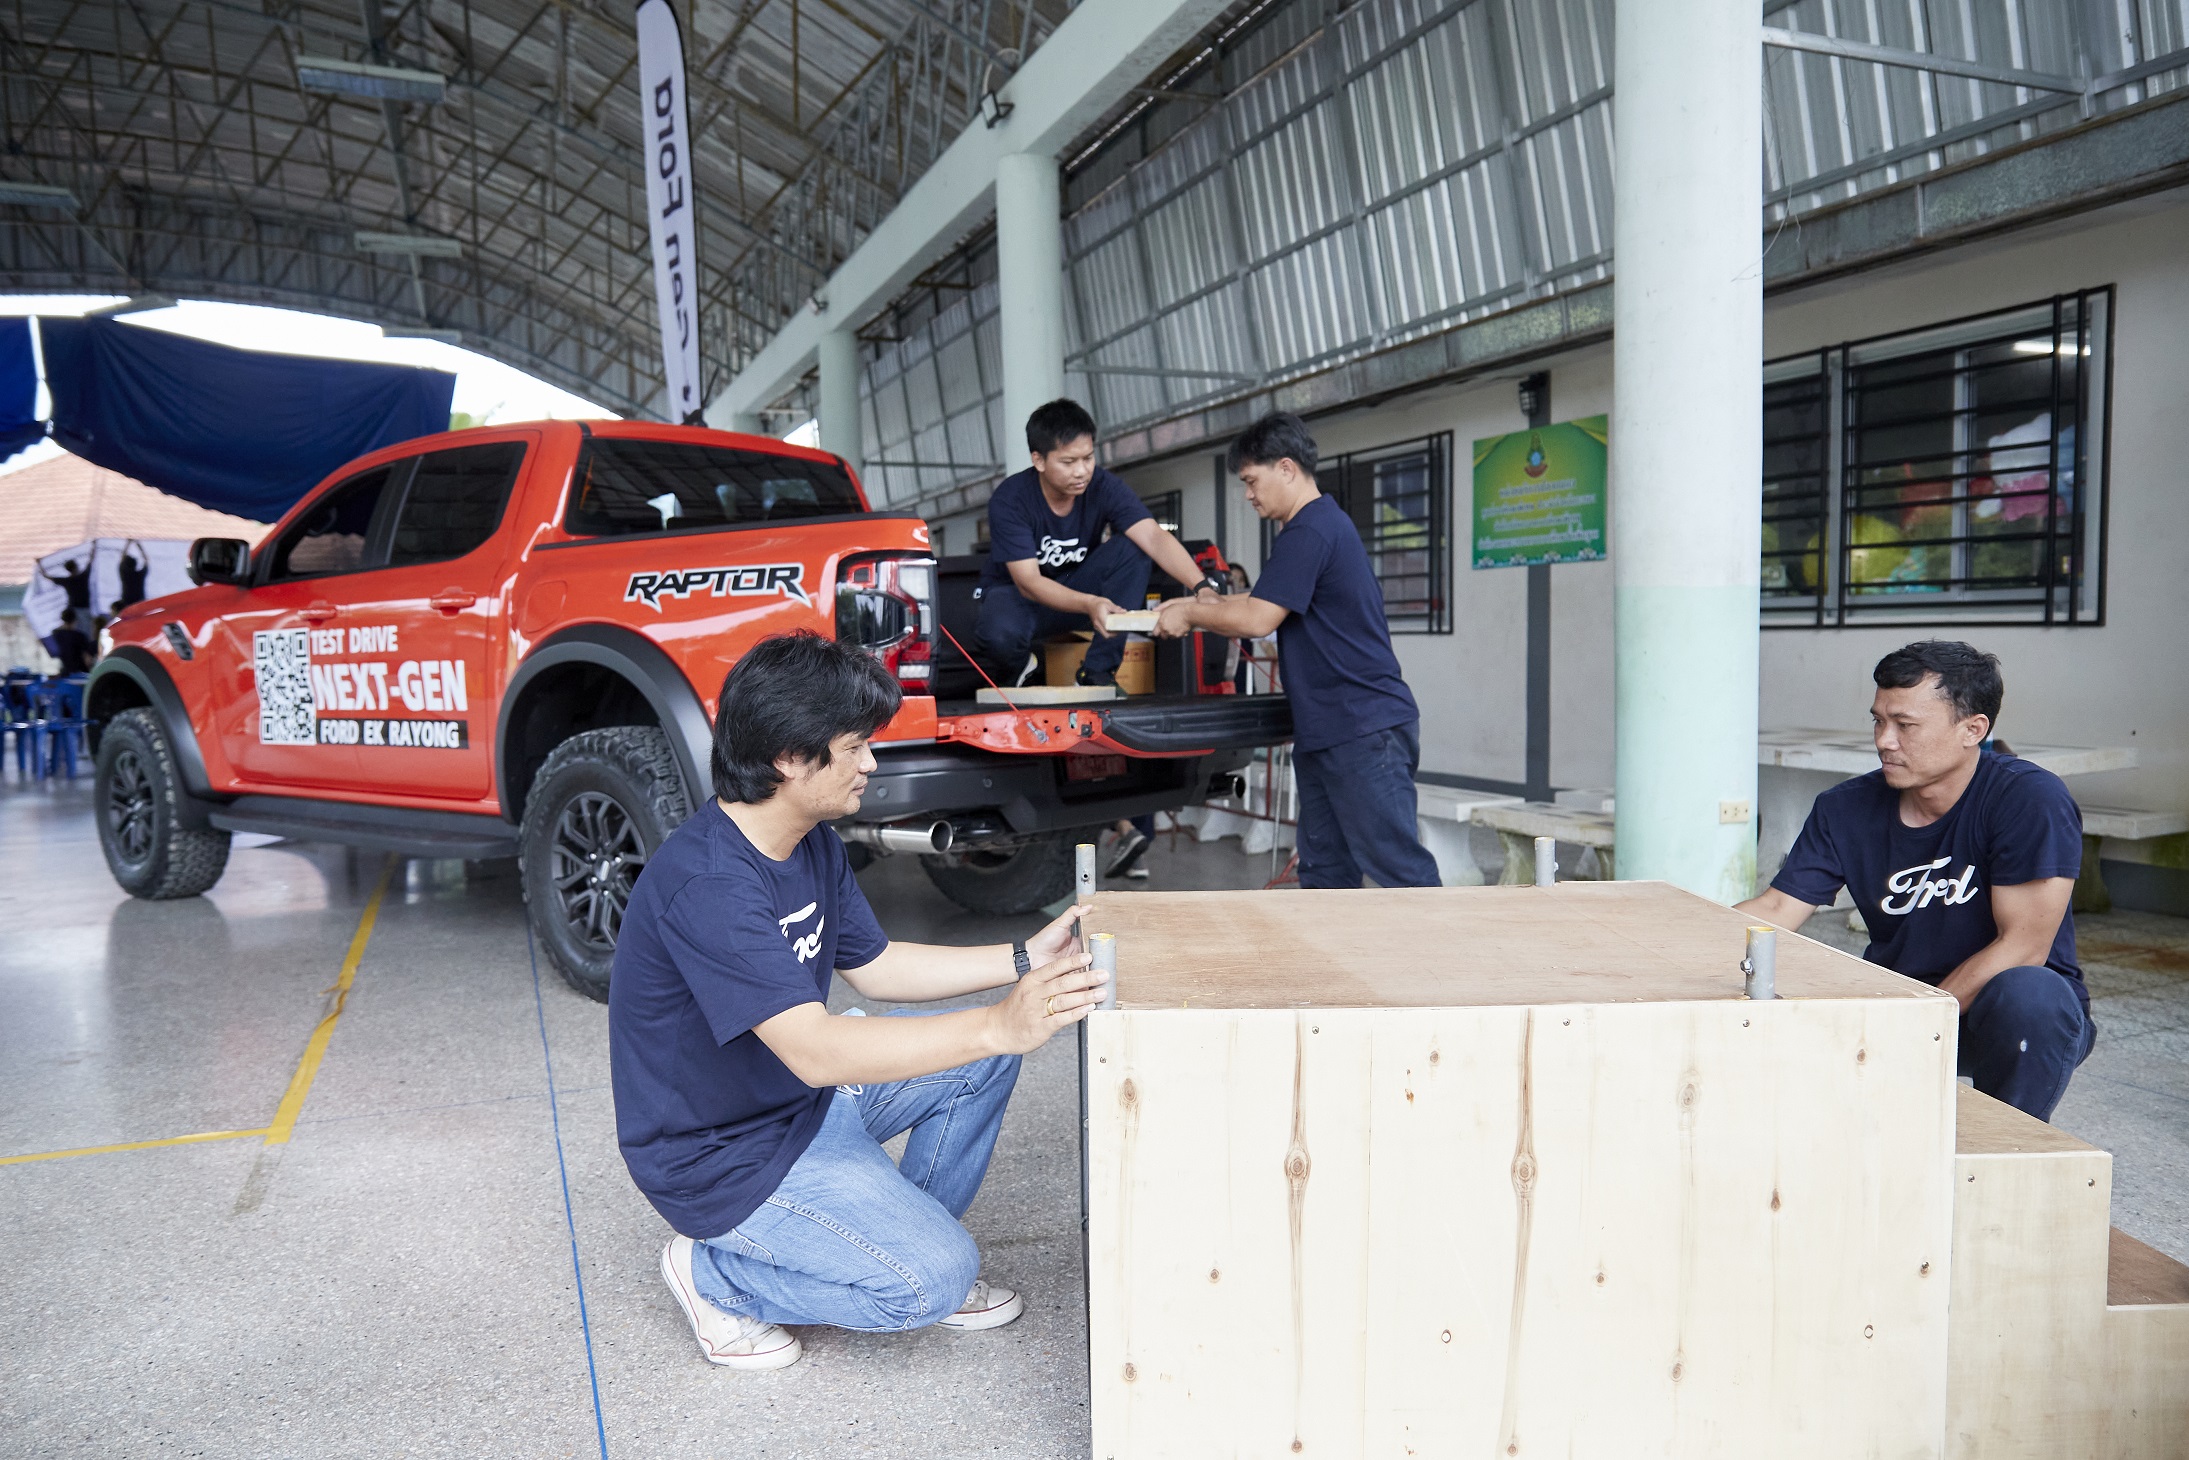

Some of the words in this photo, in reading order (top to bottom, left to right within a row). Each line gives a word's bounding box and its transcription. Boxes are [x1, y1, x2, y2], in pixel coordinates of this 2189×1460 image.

[625, 563, 812, 613] RAPTOR
[310, 629, 345, 655] TEST
[349, 625, 398, 654] DRIVE
[311, 660, 468, 711] NEXT-GEN
[319, 720, 360, 745] FORD
[363, 720, 386, 746] EK
[388, 721, 460, 748] RAYONG
